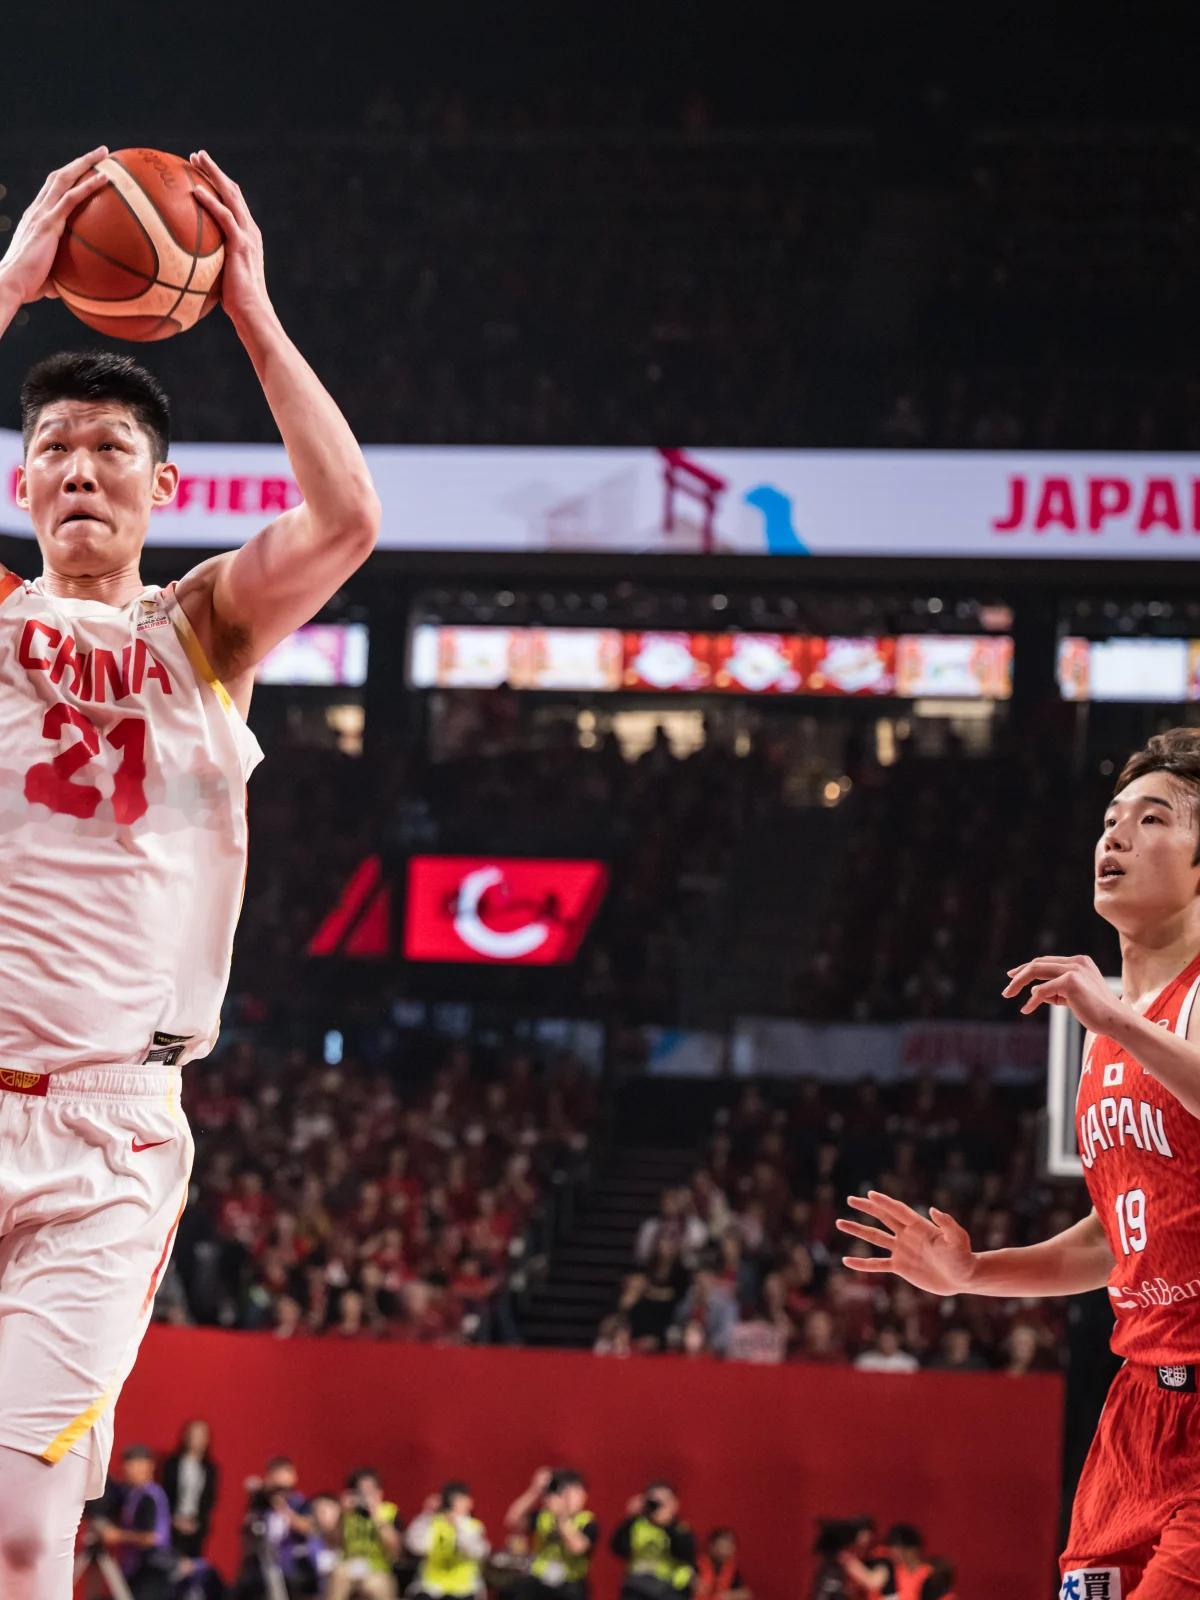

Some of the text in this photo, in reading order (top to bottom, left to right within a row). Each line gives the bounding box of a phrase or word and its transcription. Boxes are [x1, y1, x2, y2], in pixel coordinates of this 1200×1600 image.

[990, 473, 1200, 534] JAPA
[18, 619, 173, 703] CHINA
[23, 702, 149, 825] 21
[1080, 1097, 1174, 1170] JAPAN
[1115, 1188, 1147, 1256] 19
